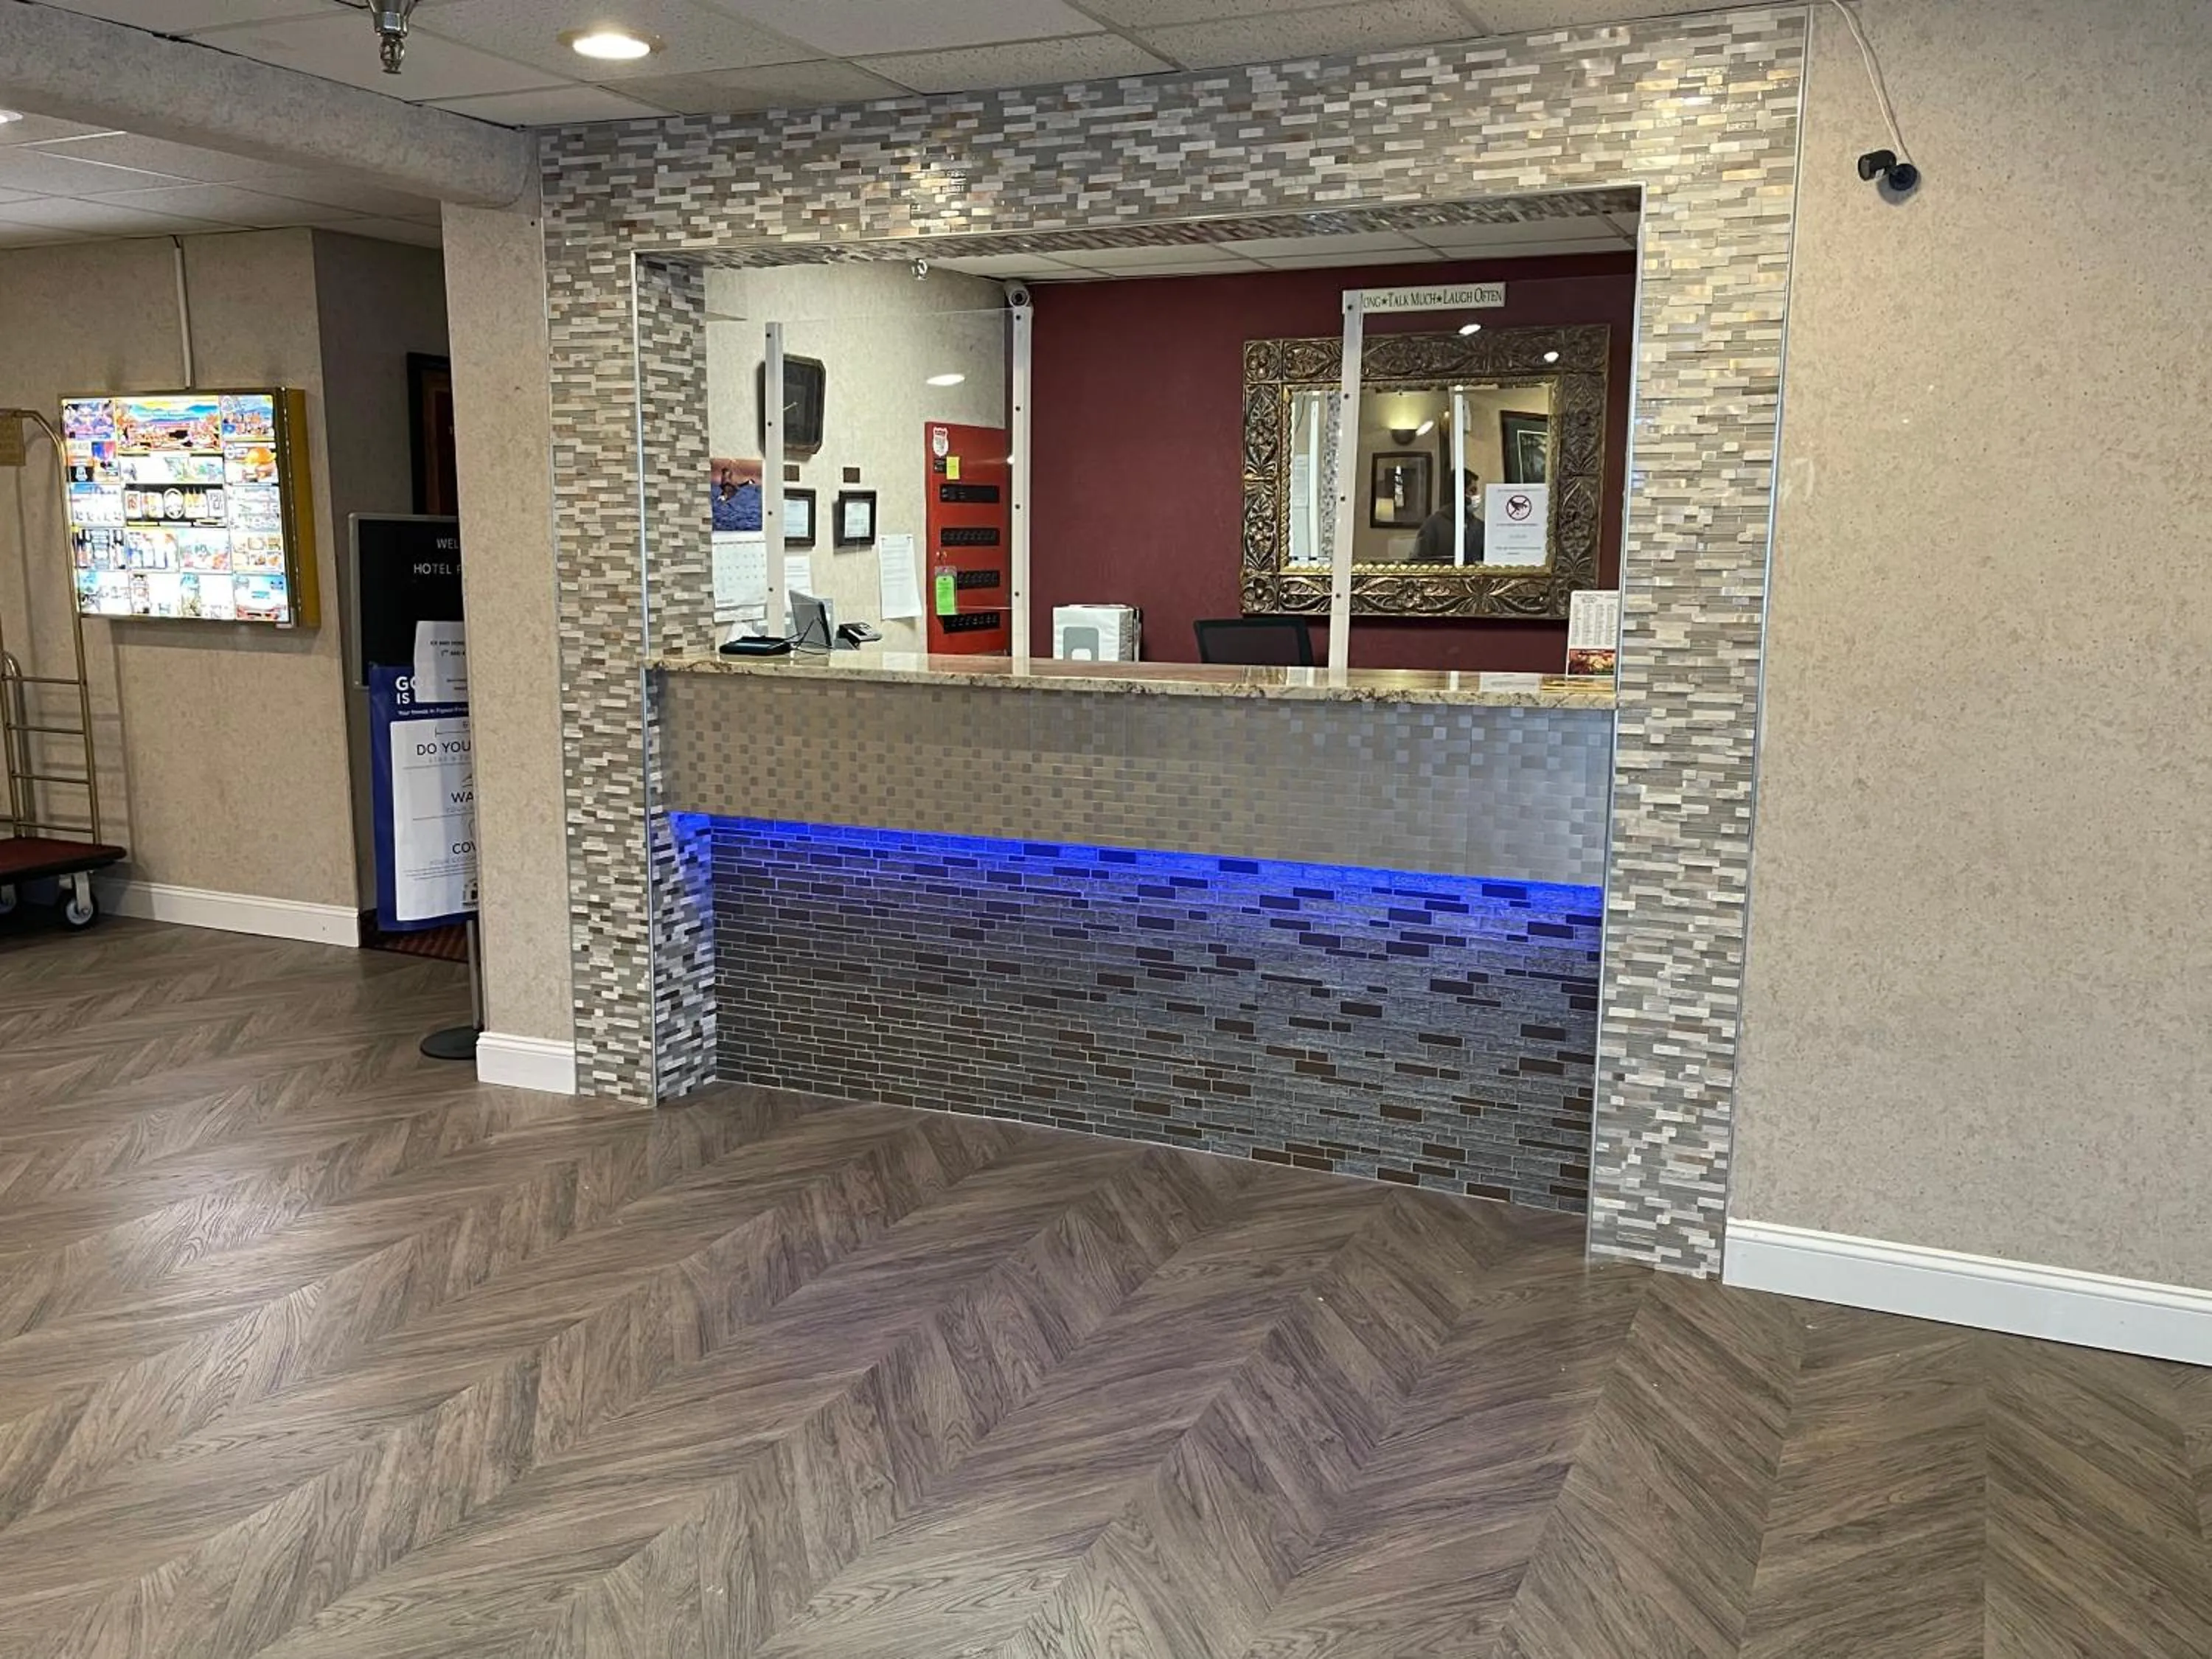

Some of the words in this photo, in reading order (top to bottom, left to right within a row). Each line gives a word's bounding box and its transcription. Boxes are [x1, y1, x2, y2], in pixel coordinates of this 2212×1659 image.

[1411, 292, 1437, 306] MUCH
[1442, 289, 1472, 305] LAUGH
[1475, 287, 1502, 302] OFTEN
[414, 563, 452, 574] HOTEL
[397, 692, 410, 705] IS
[417, 742, 437, 756] DO
[442, 740, 471, 754] YOU
